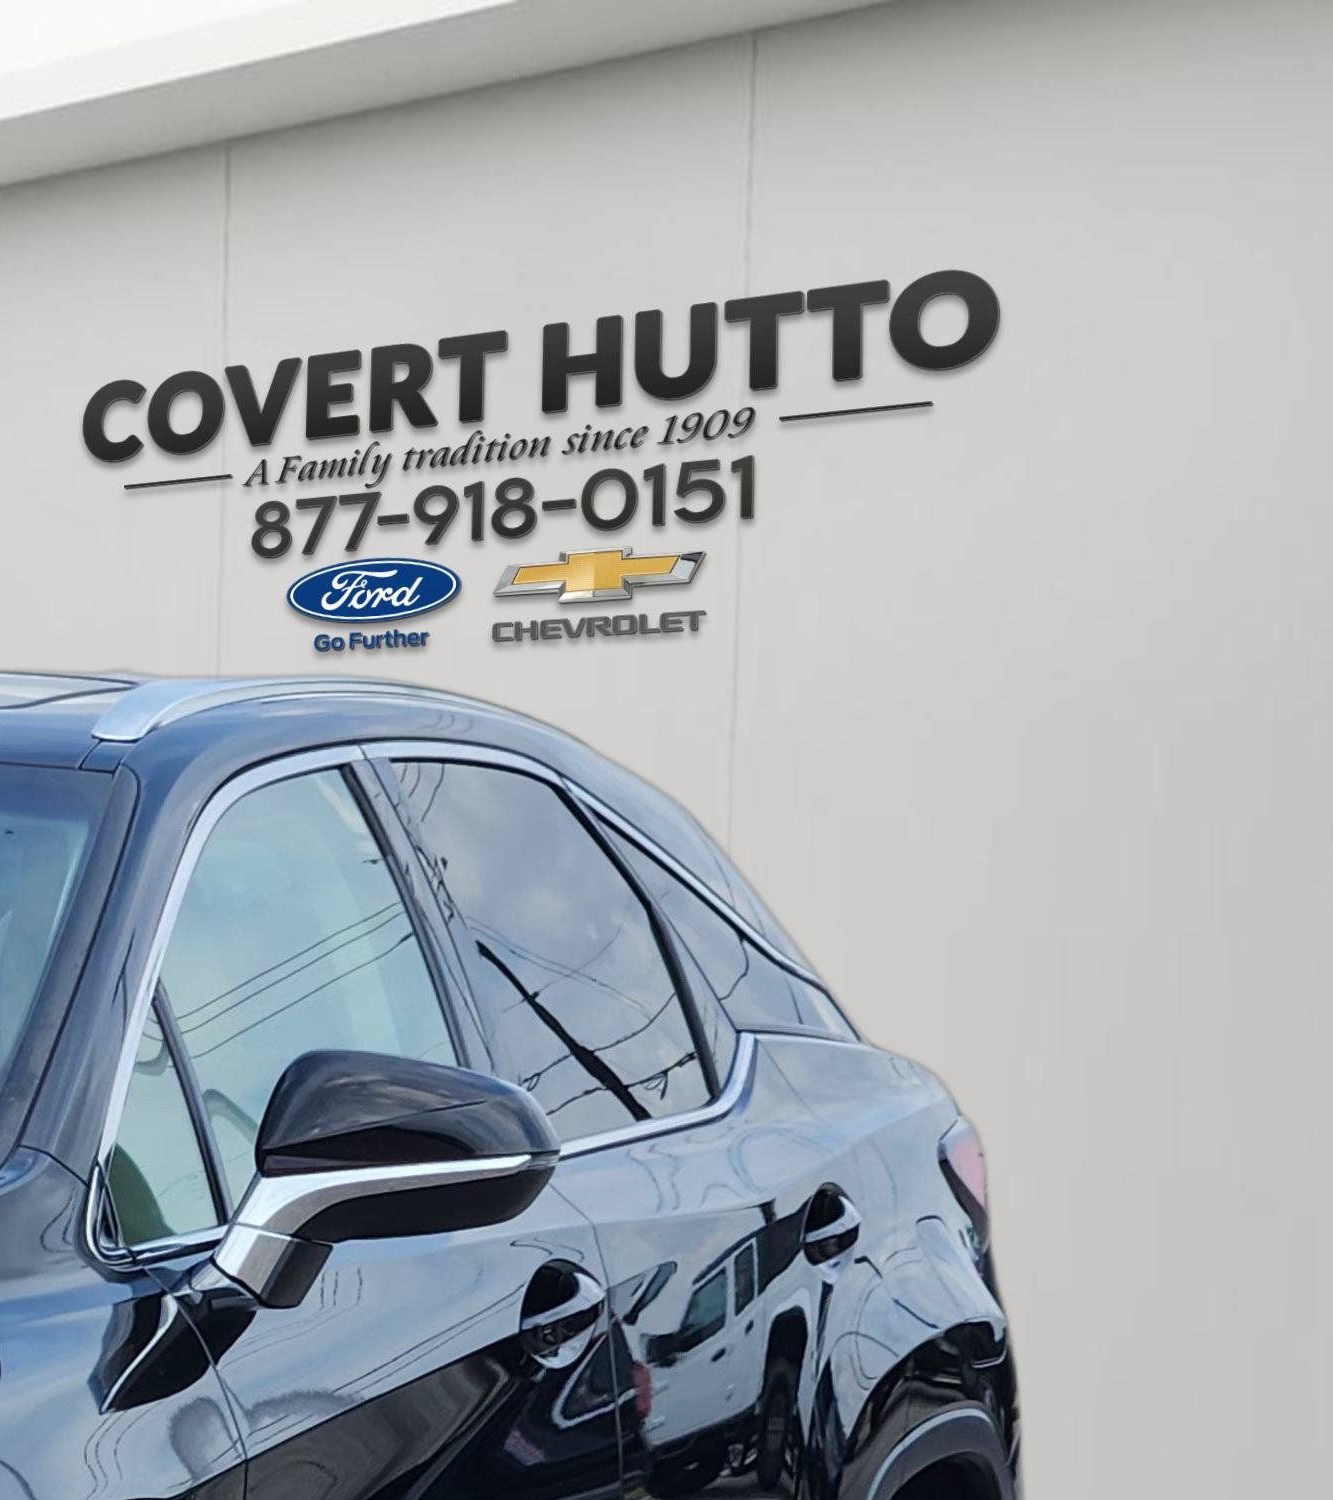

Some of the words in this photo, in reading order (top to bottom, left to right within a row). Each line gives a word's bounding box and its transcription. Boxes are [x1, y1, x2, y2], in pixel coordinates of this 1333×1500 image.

[82, 330, 509, 464] COVERT
[541, 269, 1001, 415] HUTTO
[242, 458, 270, 488] A
[275, 440, 392, 489] Family
[402, 429, 552, 472] tradition
[561, 423, 650, 456] since
[657, 406, 757, 446] 1909
[251, 455, 755, 560] 877-918-0151
[320, 569, 422, 609] Ford
[313, 633, 344, 653] Go
[348, 629, 430, 650] Further
[491, 609, 708, 643] CHEVROLET
